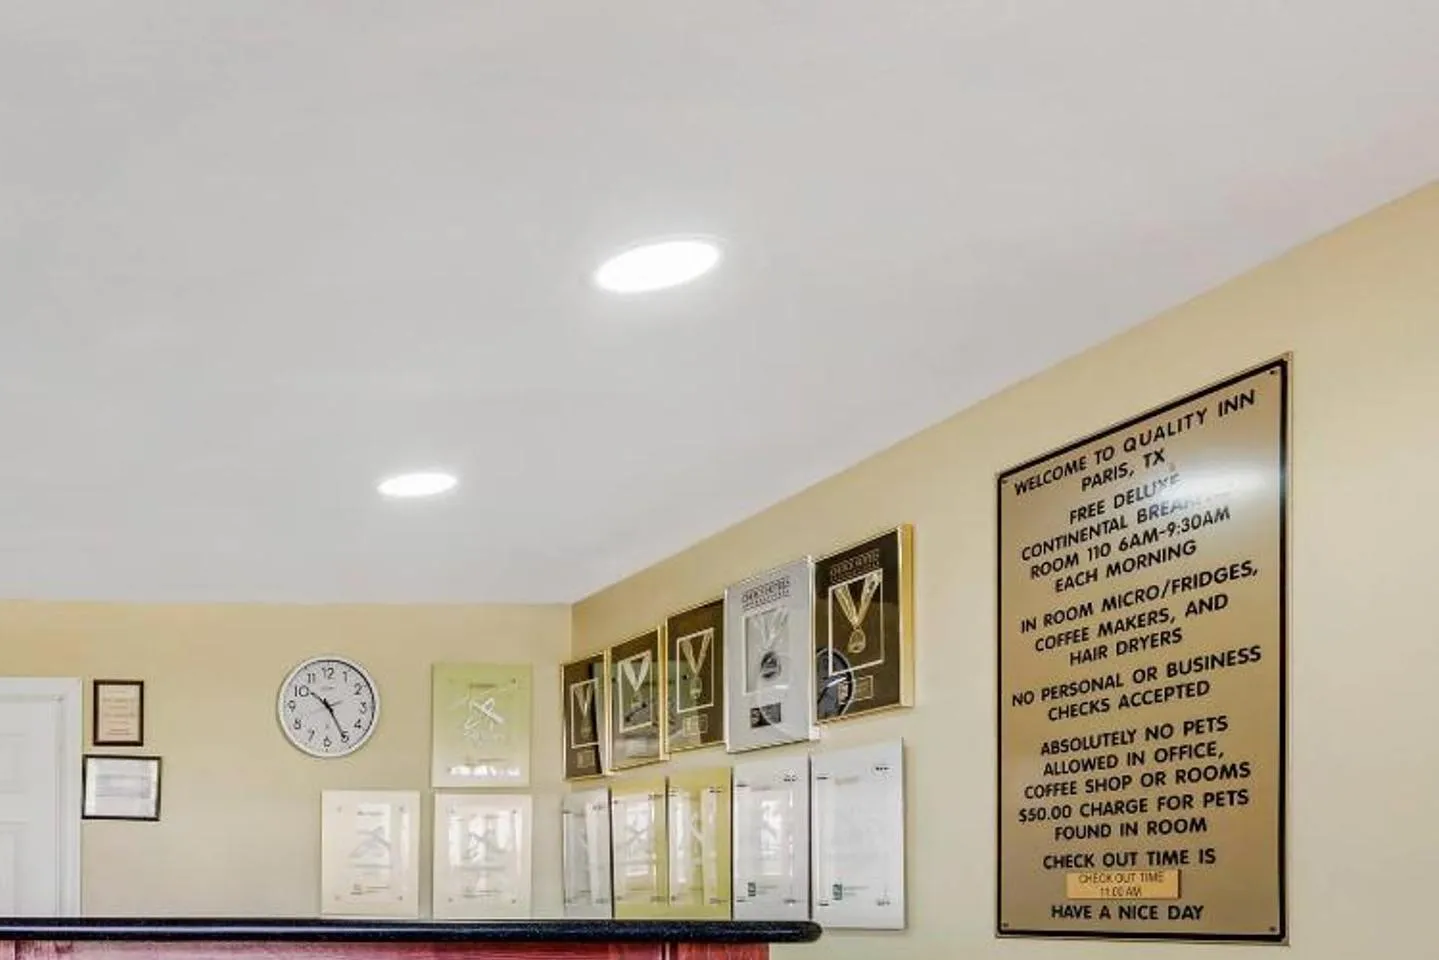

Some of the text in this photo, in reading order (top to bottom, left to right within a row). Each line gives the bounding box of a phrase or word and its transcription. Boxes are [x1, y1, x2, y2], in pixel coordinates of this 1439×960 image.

[1014, 389, 1255, 496] WELCOME TO QUALITY INN
[1081, 448, 1166, 491] PARIS, TX
[1069, 503, 1106, 525] FREE
[1021, 515, 1128, 561] CONTINENTAL
[1030, 506, 1231, 579] ROOM 110 6AM-9:30AM
[1055, 540, 1197, 593] EACH MORNING
[1021, 560, 1258, 633] IN ROOM MICRO/FRIDGES,
[1035, 593, 1229, 651] COFFEE MAKERS, AND
[1069, 628, 1183, 666] HAIR DRYERS
[294, 685, 309, 697] 10
[307, 673, 316, 683] 11
[322, 668, 334, 679] 12
[343, 671, 348, 682] 1
[354, 683, 363, 695] 2
[1011, 646, 1262, 707] NO PERSONAL OR BUSINESS
[360, 702, 367, 714] 3
[1048, 680, 1210, 721] CHECKS ACCEPTED
[354, 719, 361, 728] 4
[1040, 715, 1229, 756] ABSOLUTELY NO PETS
[1043, 741, 1224, 777] ALLOWED IN OFFICE,
[1024, 762, 1251, 799] COFFEE SHOP OR ROOMS
[1018, 790, 1249, 824] $50.00 CHARGE FOR PETS
[1054, 817, 1207, 841] FOUND IN ROOM
[1043, 848, 1216, 869] CHECK OUT TIME IS
[1115, 872, 1136, 883] OUT
[1140, 871, 1164, 883] TIME
[1051, 905, 1204, 920] HAVE A NICE DAY
